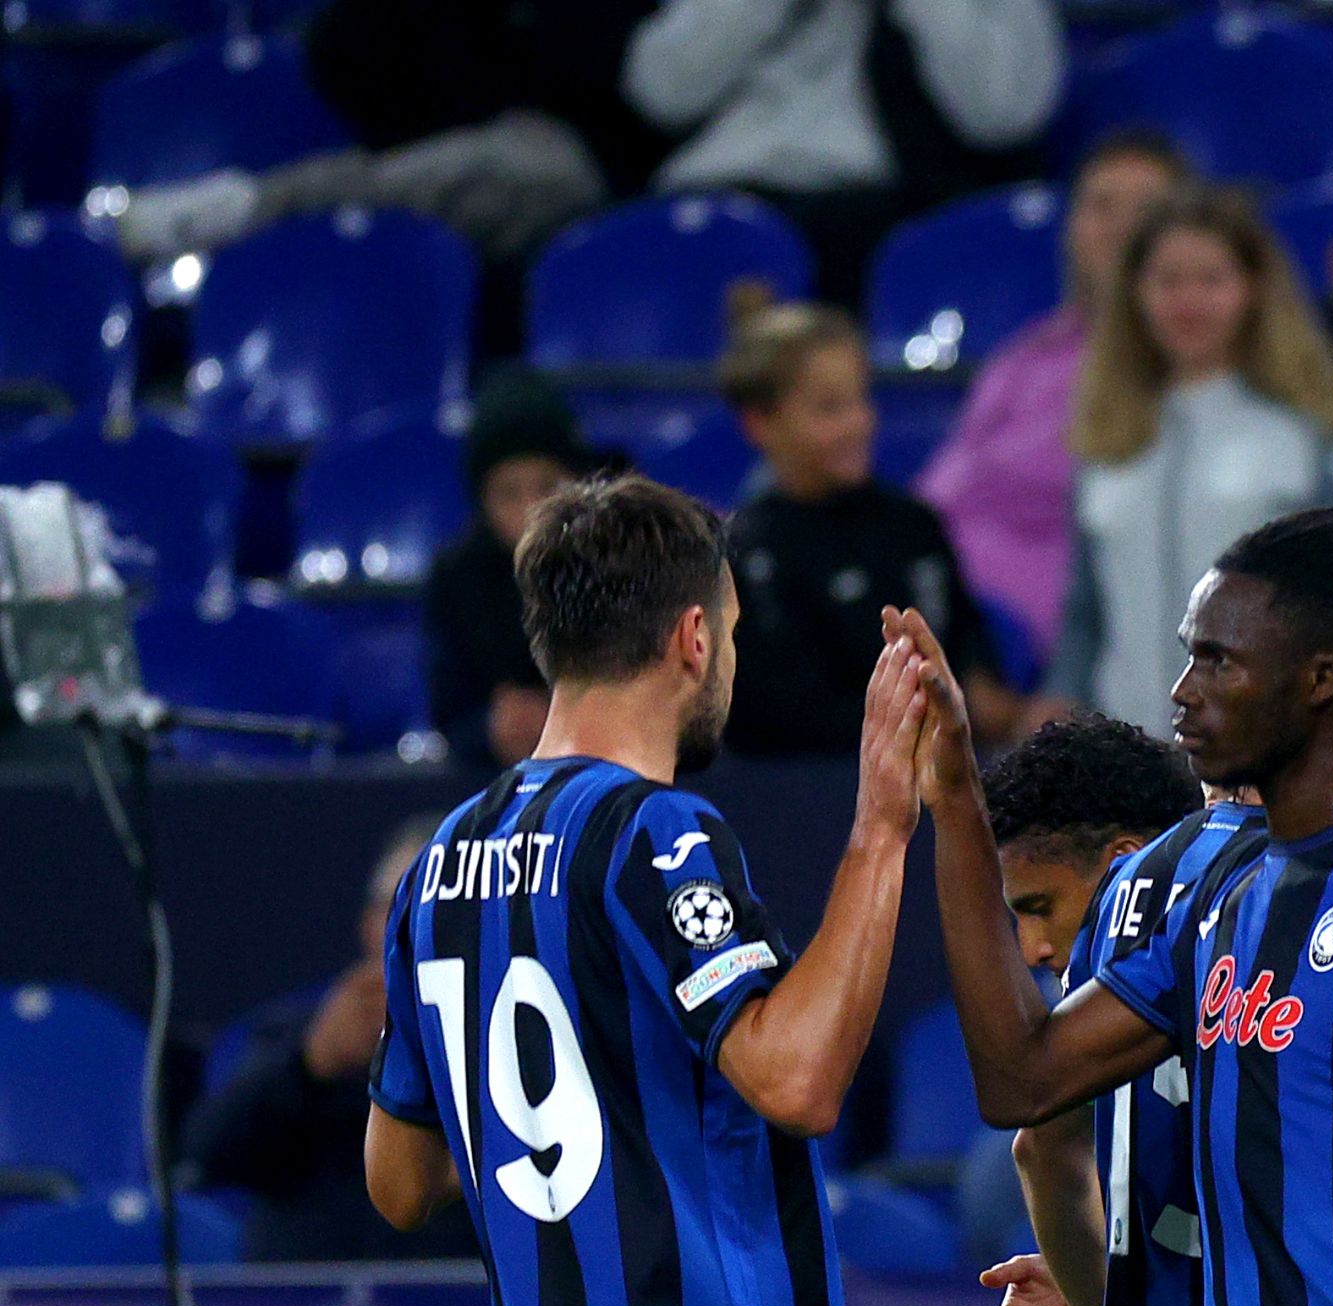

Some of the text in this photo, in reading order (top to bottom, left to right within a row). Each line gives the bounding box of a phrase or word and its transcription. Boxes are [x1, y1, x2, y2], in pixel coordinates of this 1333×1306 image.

[420, 831, 564, 904] DJIMSITI
[1108, 878, 1153, 938] DE
[1196, 954, 1304, 1053] Lete
[417, 955, 603, 1223] 19
